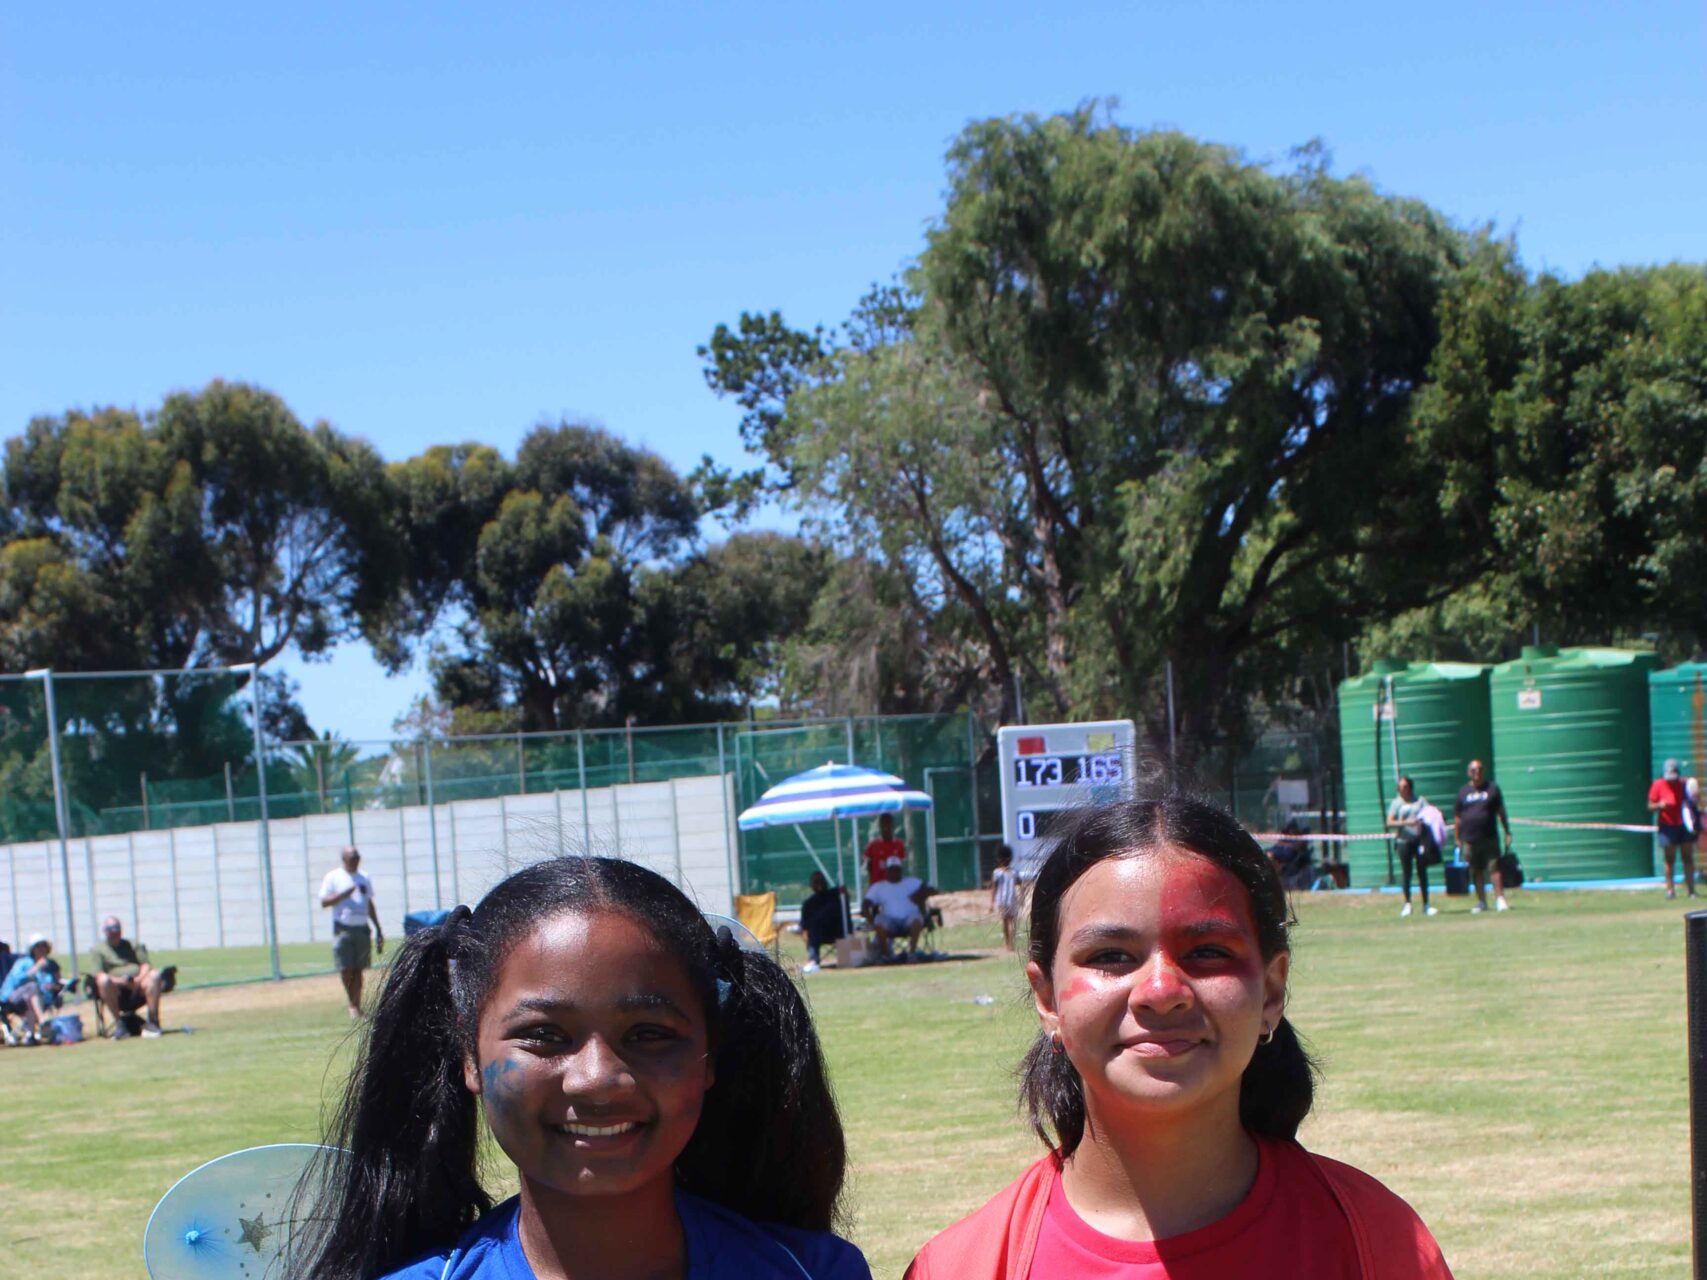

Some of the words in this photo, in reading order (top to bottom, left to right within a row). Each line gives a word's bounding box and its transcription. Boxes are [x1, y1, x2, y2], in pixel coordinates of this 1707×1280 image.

[1016, 757, 1063, 787] 173
[1077, 754, 1122, 784] 165
[1017, 811, 1035, 840] 0
